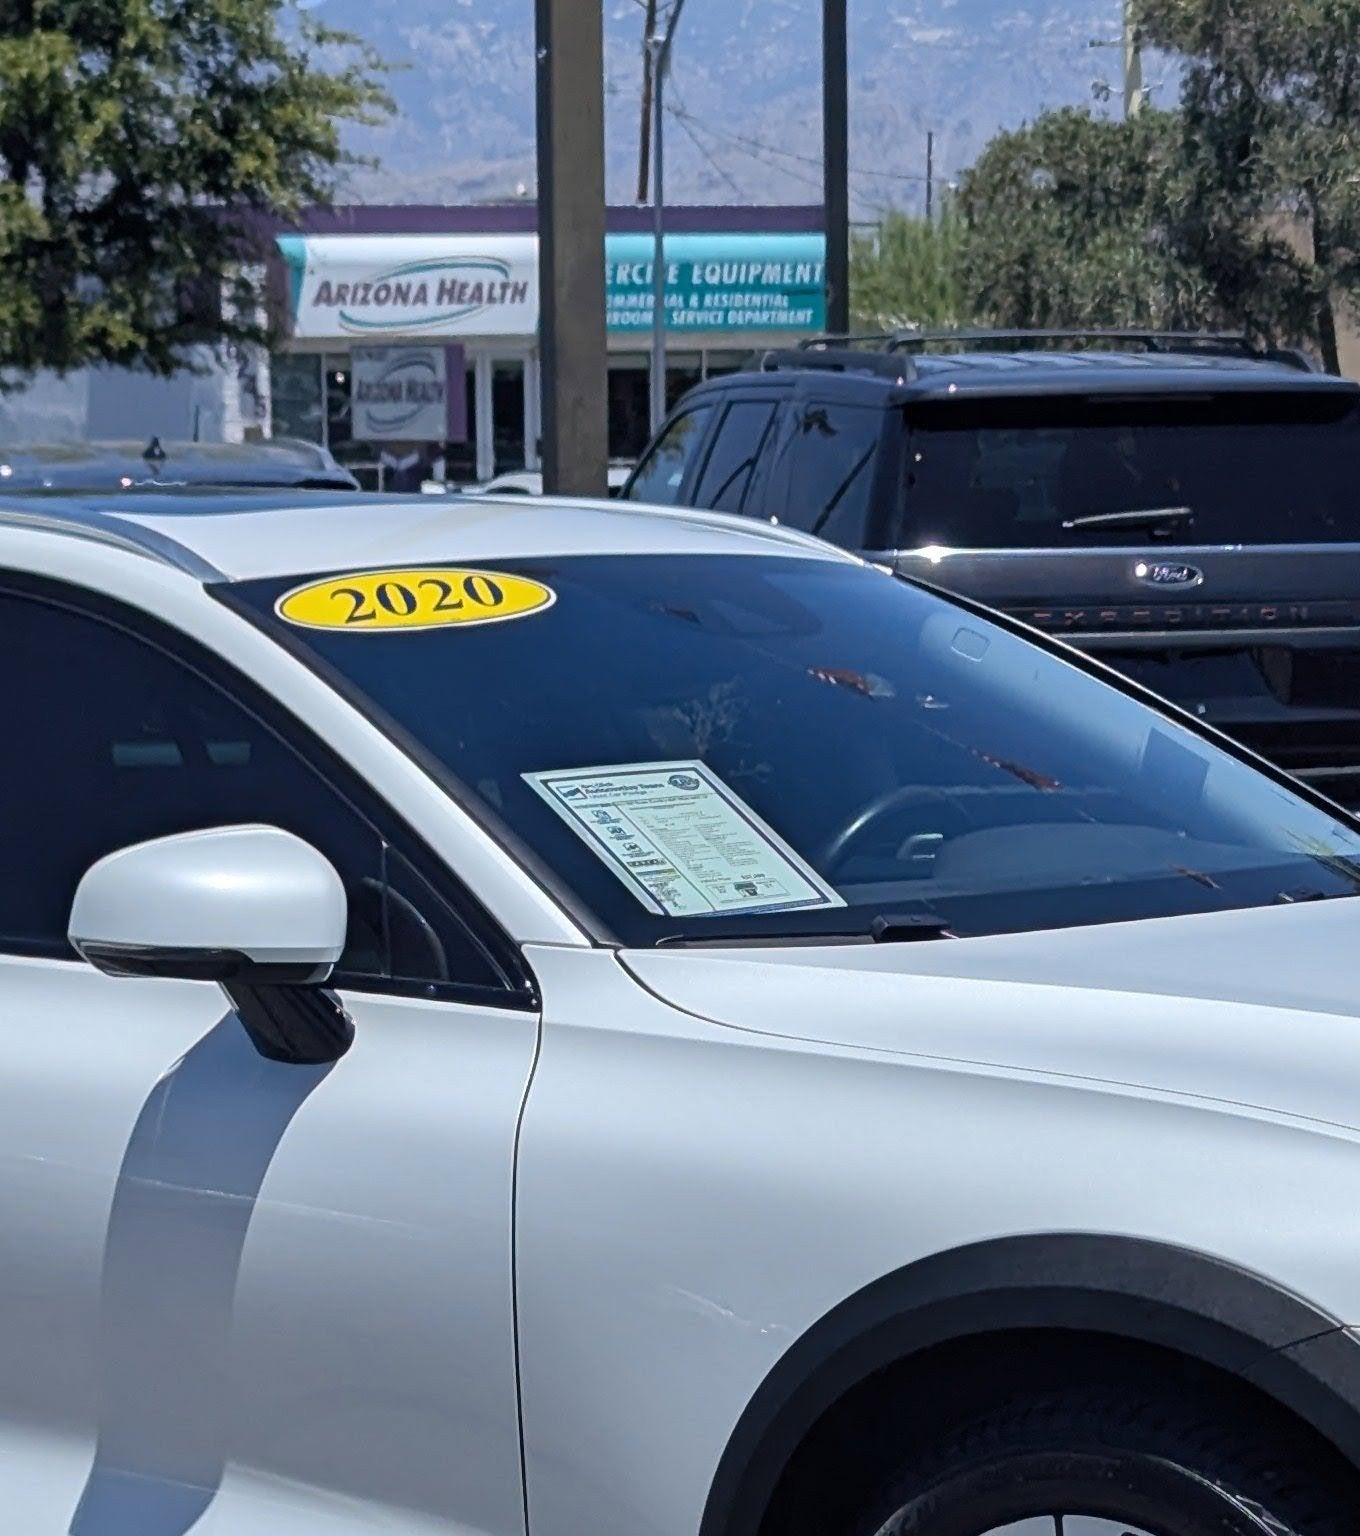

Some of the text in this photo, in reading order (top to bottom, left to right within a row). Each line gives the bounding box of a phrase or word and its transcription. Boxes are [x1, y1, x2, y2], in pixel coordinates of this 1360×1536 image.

[606, 262, 825, 285] ERCIE EQUIPMENT
[312, 279, 528, 307] ARIZONA HEALTH
[704, 292, 789, 308] RESIDENTIAL
[671, 310, 725, 325] SERVICE
[728, 309, 814, 325] DEPARTMENT
[330, 575, 504, 624] 2020
